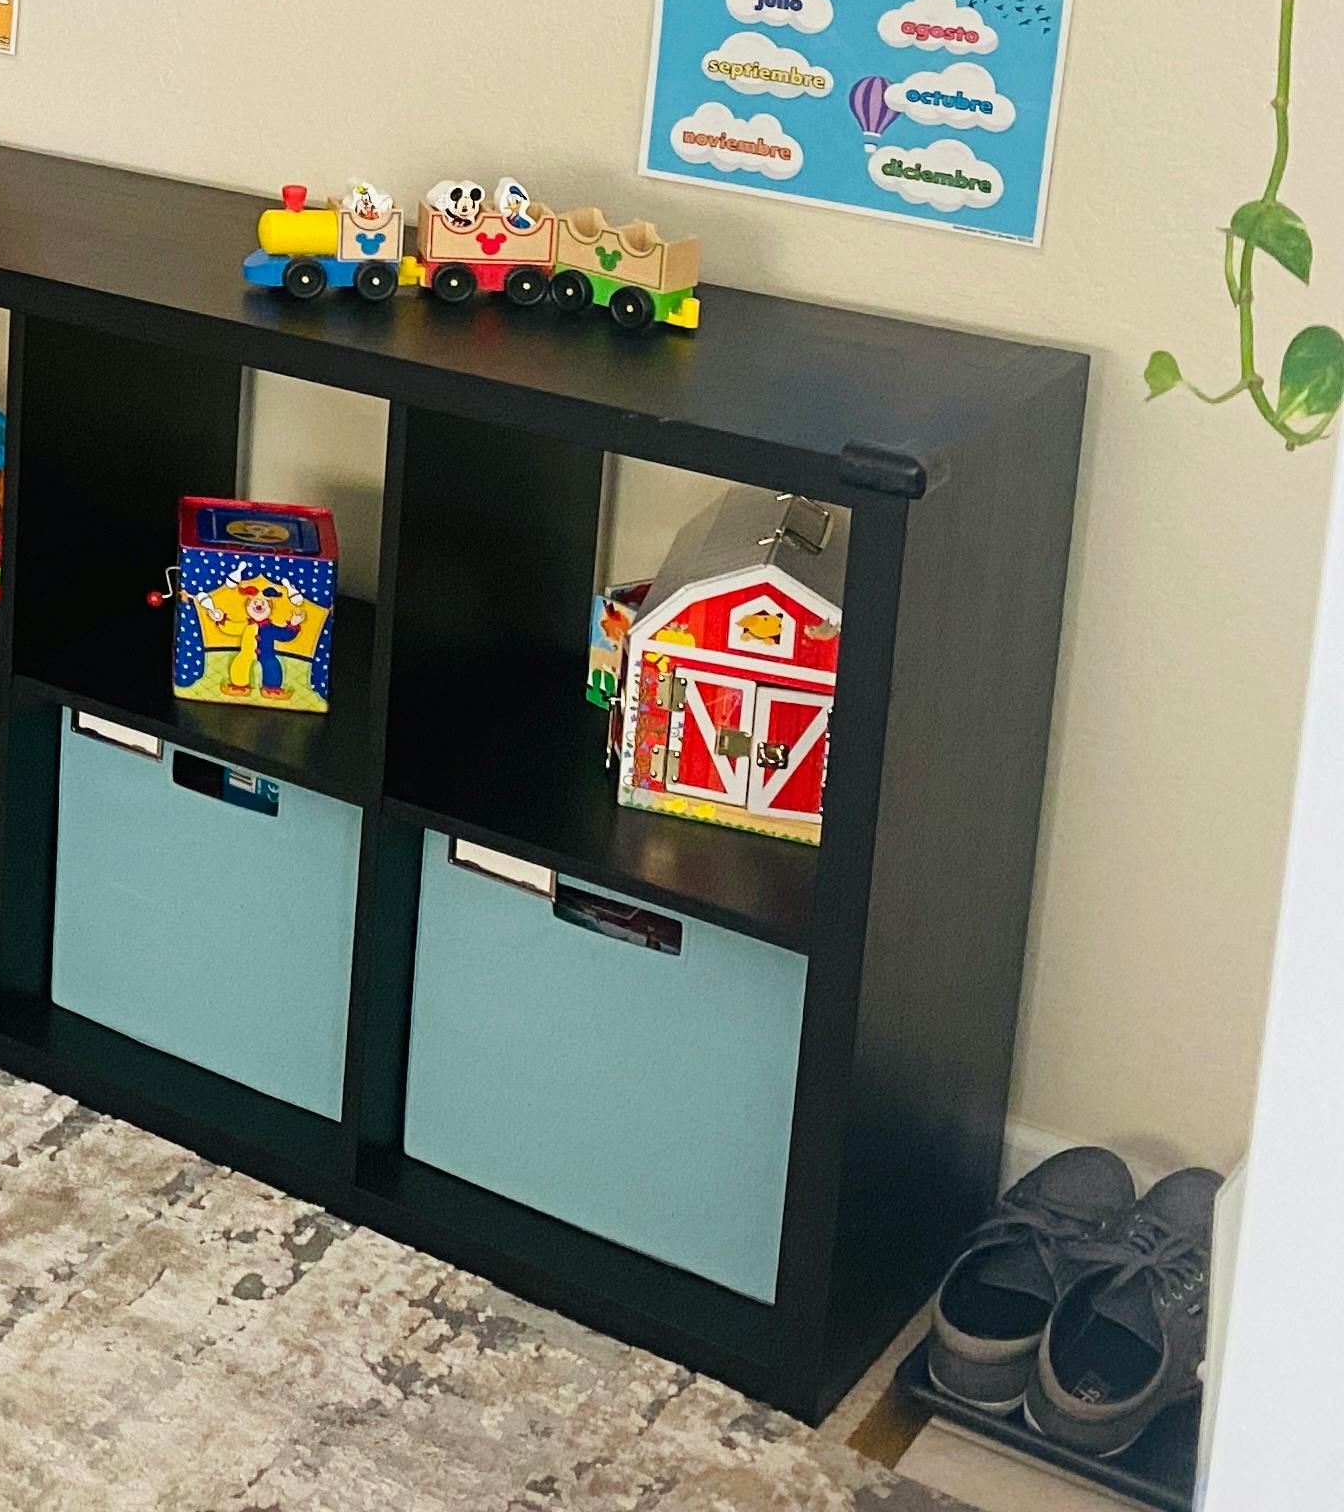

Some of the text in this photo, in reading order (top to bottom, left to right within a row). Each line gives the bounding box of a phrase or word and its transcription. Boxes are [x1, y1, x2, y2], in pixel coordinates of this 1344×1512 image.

[900, 20, 980, 45] agosto
[707, 58, 994, 115] septiembre octubre
[682, 130, 993, 194] noviembre diciembre
